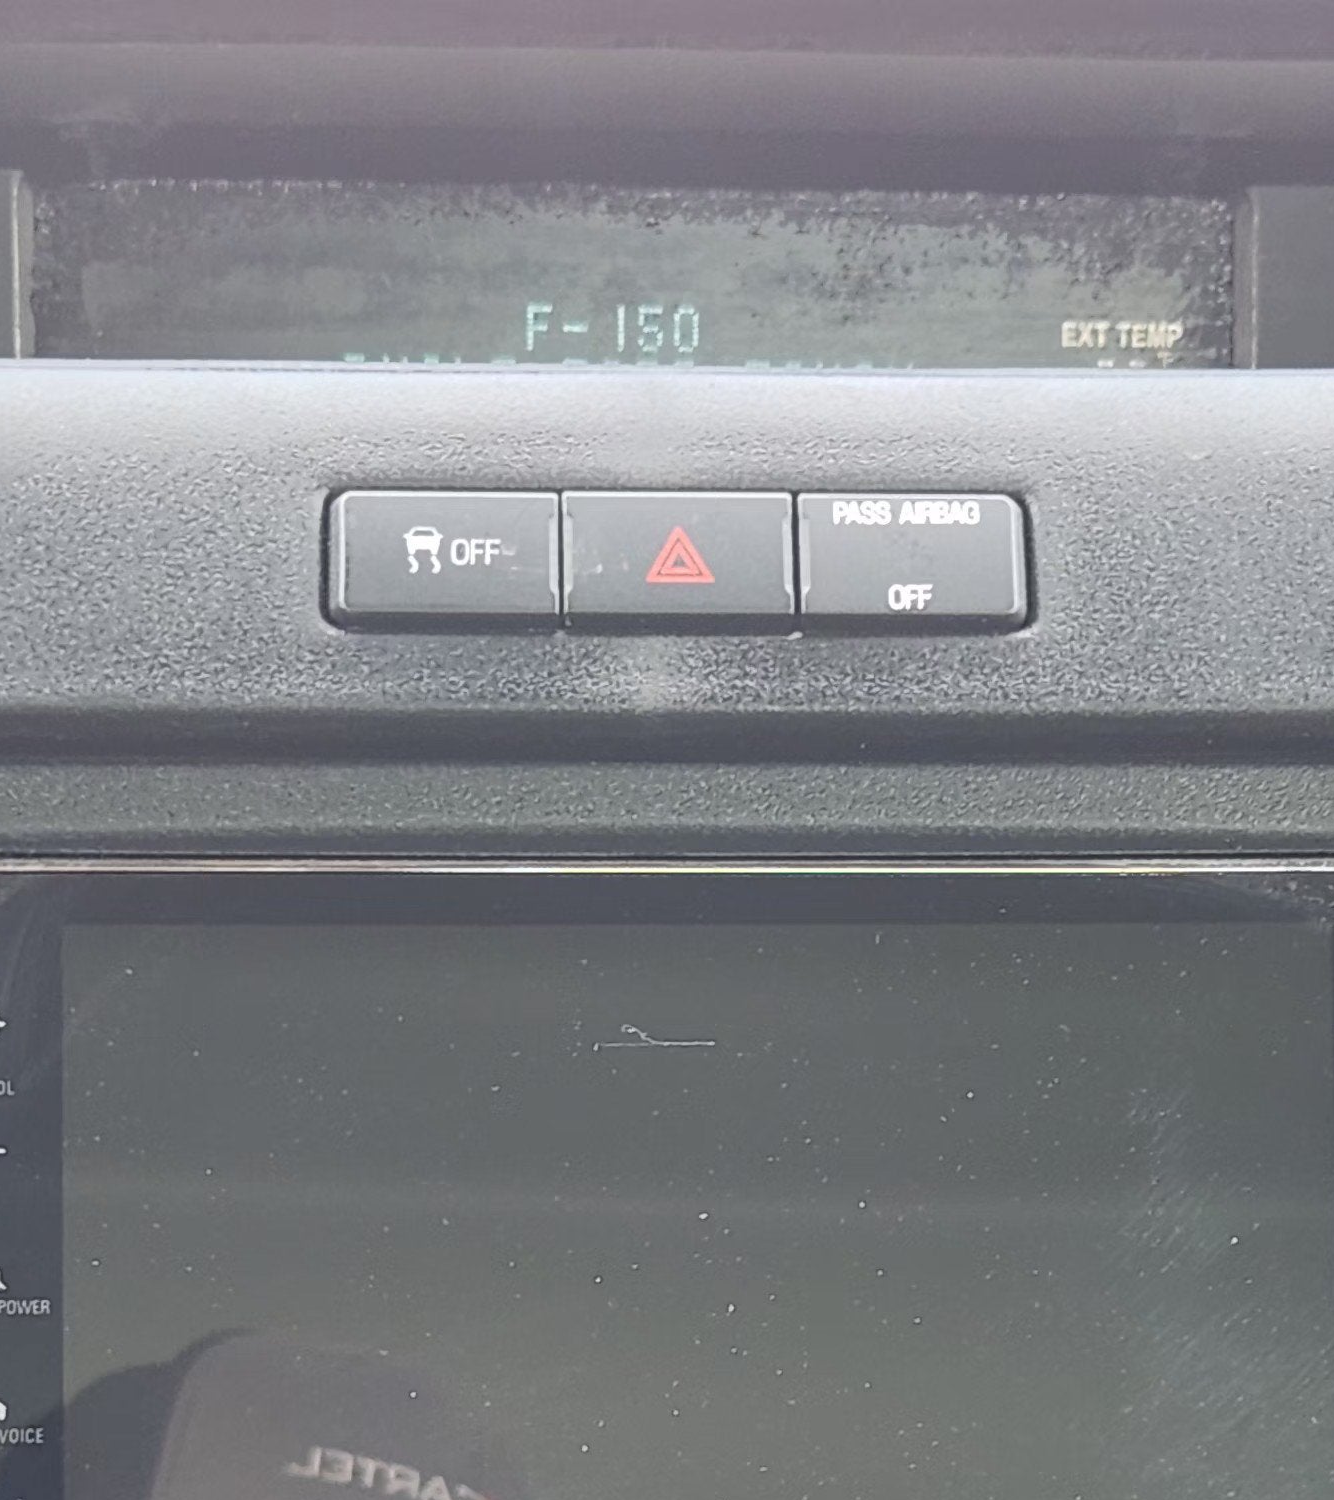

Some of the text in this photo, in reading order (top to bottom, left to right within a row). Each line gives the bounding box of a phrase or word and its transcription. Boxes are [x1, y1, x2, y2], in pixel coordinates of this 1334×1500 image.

[1061, 318, 1184, 348] EXT TEMP
[832, 500, 981, 525] PASS AIRBAG
[450, 538, 502, 567] OFF
[887, 583, 933, 611] OFF
